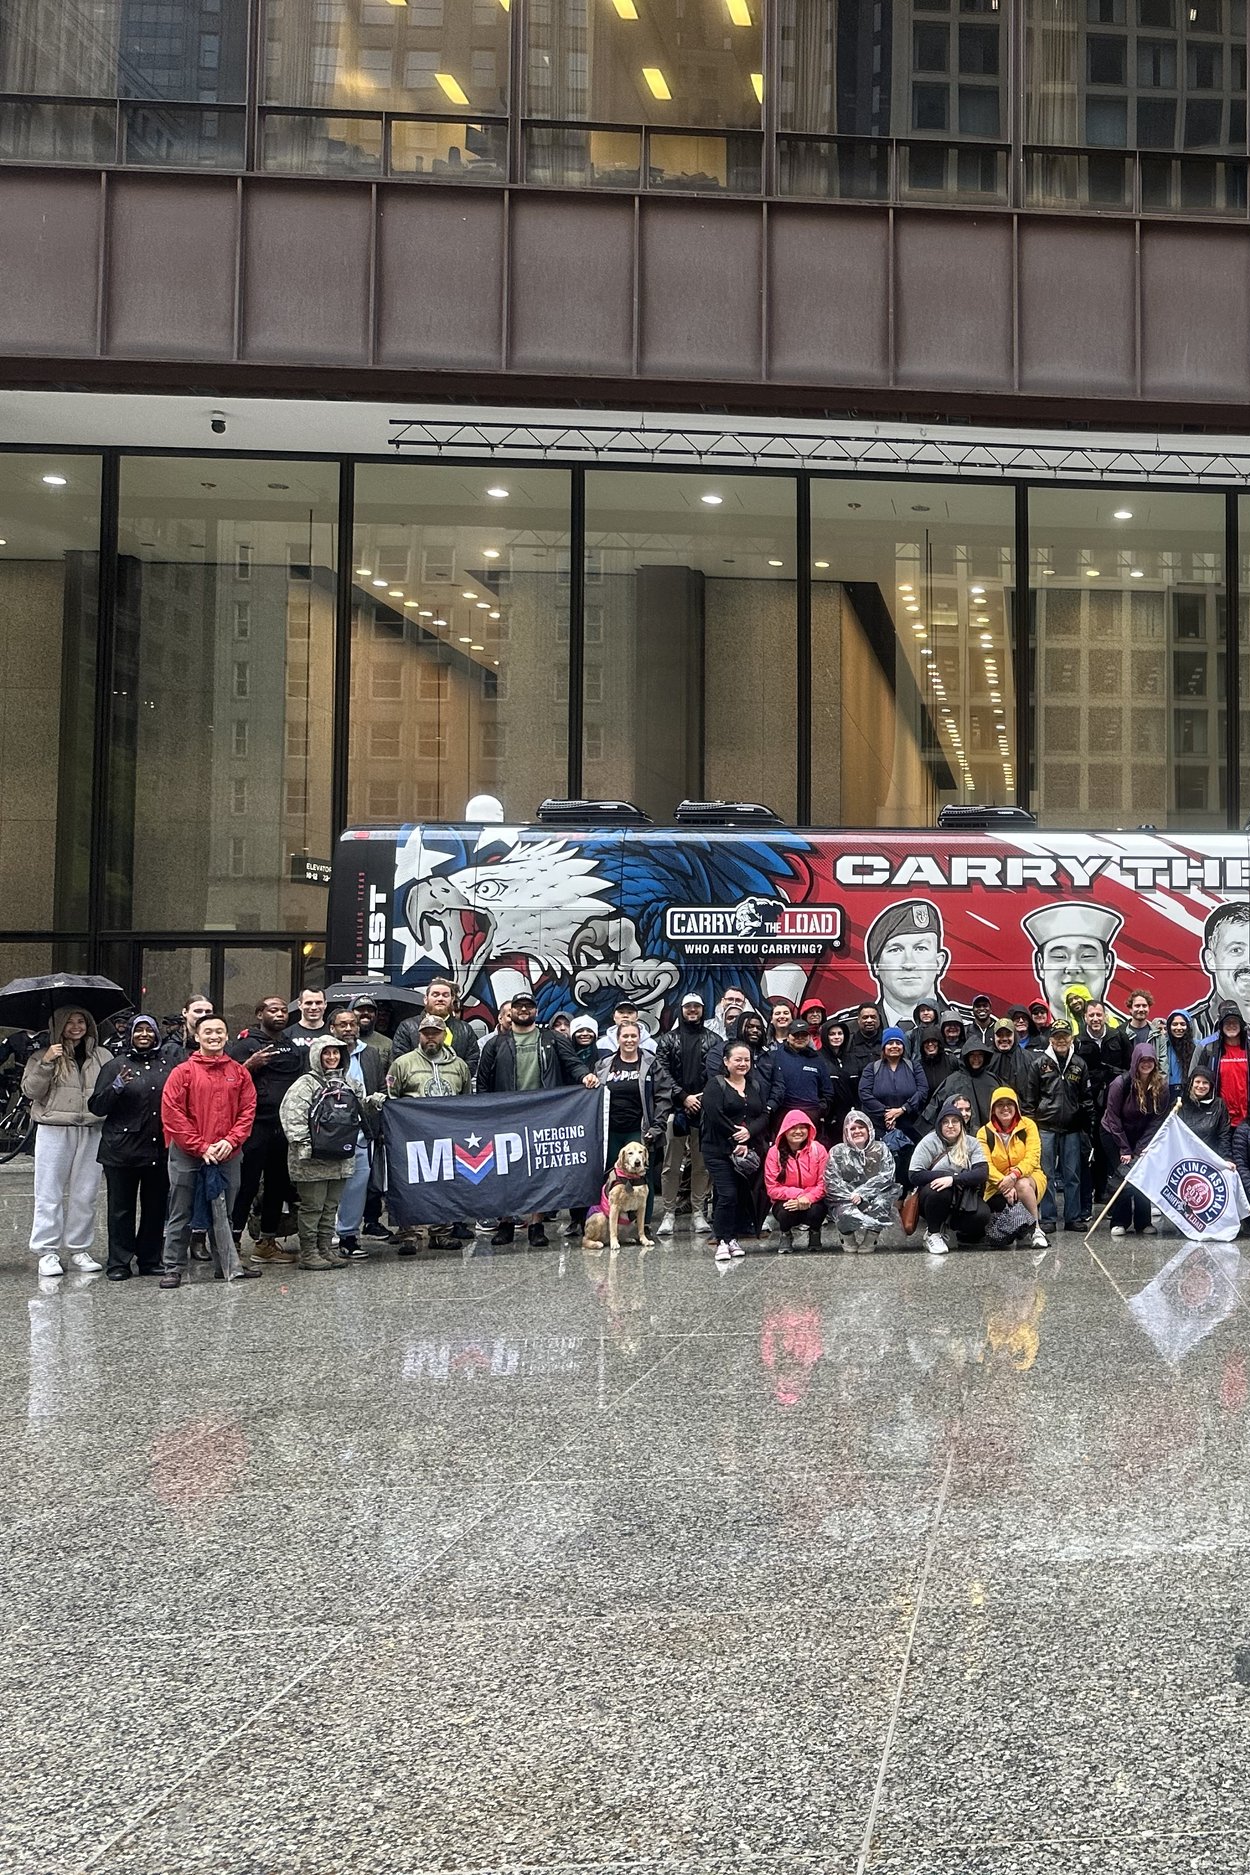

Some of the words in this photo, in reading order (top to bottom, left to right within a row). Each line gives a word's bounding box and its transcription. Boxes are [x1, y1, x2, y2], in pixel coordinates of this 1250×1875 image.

[833, 855, 1107, 889] CARRY
[357, 871, 366, 901] TEXAS
[673, 913, 736, 934] CARRY
[764, 921, 782, 933] THE
[784, 913, 833, 933] LOAD
[684, 944, 710, 954] WHO
[712, 944, 734, 954] ARE
[738, 944, 760, 954] YOU
[762, 944, 823, 955] CARRYING?
[532, 1125, 585, 1143] MERGING
[534, 1141, 561, 1157] VETS
[562, 1139, 570, 1153] &
[406, 1132, 524, 1185] MVP
[535, 1151, 587, 1170] PLAYERS
[1169, 1162, 1208, 1186] KICKING
[1204, 1171, 1226, 1221] ASPHALT
[1188, 1214, 1204, 1230] LOAD
